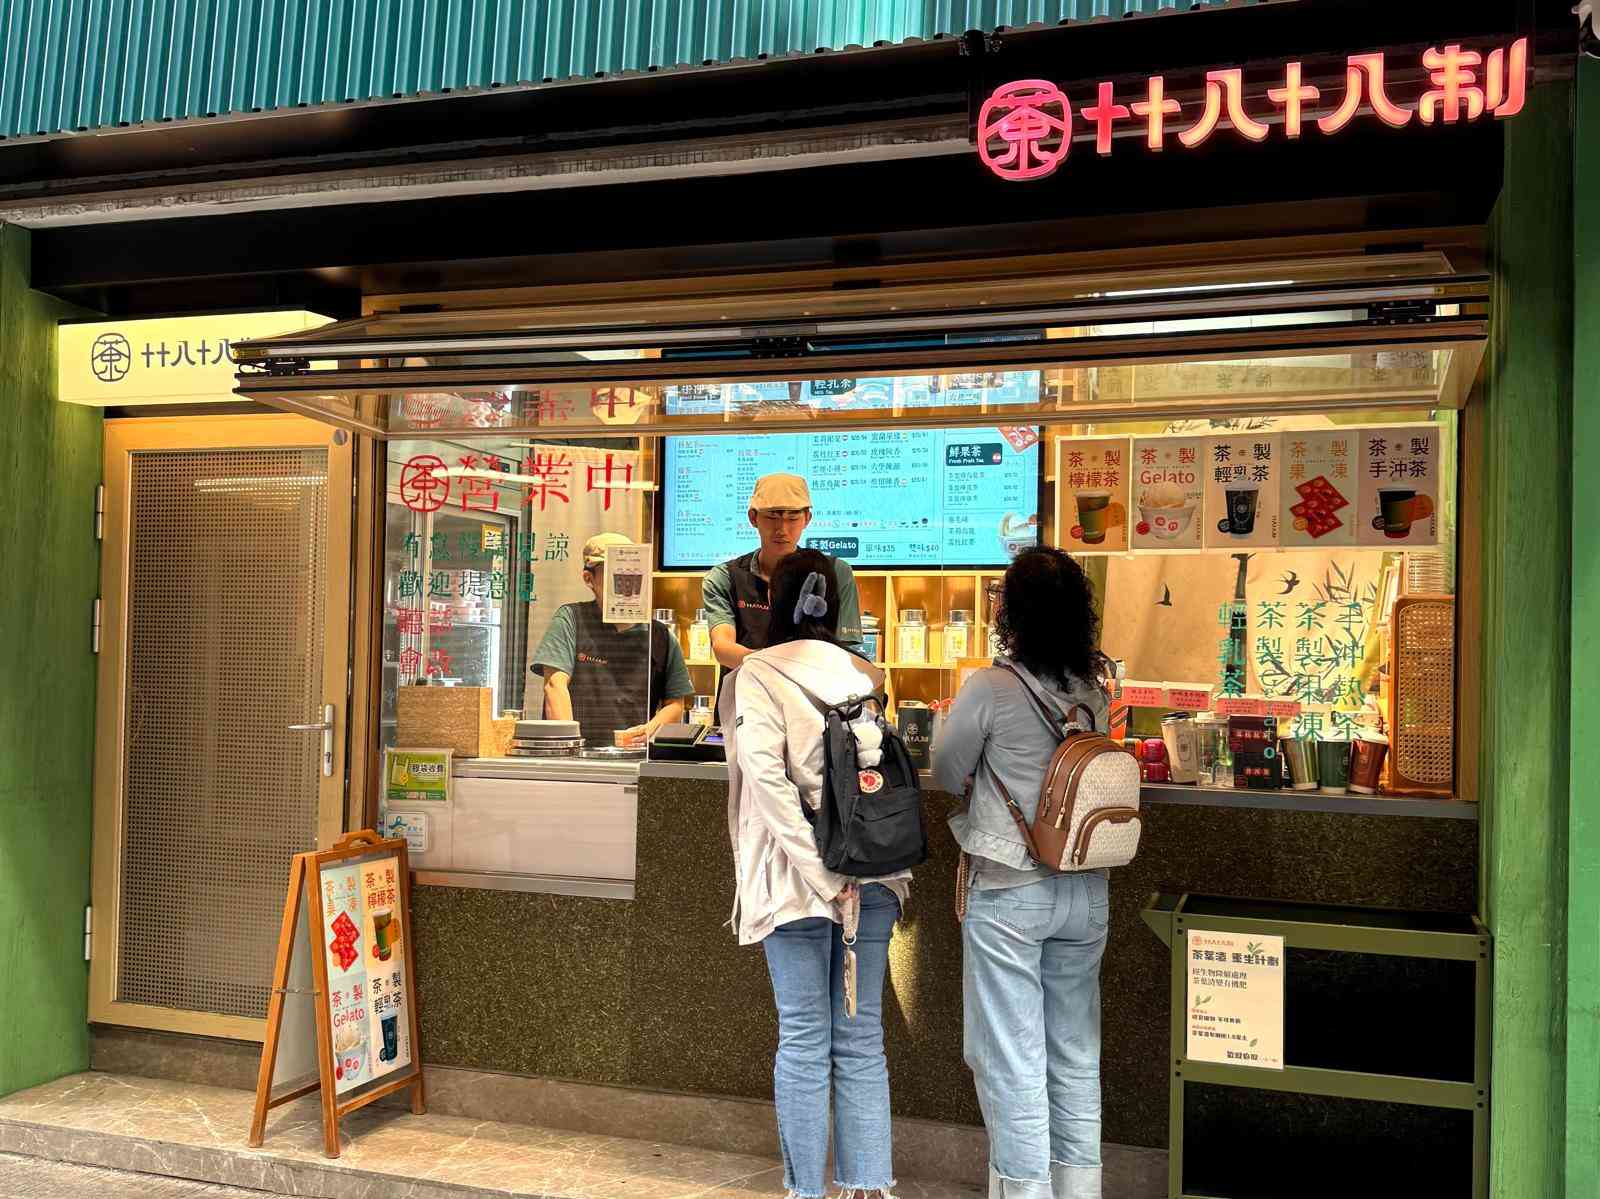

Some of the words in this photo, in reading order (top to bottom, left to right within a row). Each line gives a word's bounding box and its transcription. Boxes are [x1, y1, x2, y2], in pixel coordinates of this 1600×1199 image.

[141, 338, 250, 369] 十十八十八
[949, 445, 982, 457] 鮮果茶
[1141, 469, 1195, 485] Gelato
[1214, 464, 1270, 483] 輕乳茶
[1369, 460, 1427, 478] 手沖茶
[458, 452, 632, 512] 營業中
[1069, 470, 1120, 488] 檸檬茶
[399, 571, 537, 602] 歡迎提意見
[333, 1008, 365, 1027] Gelato
